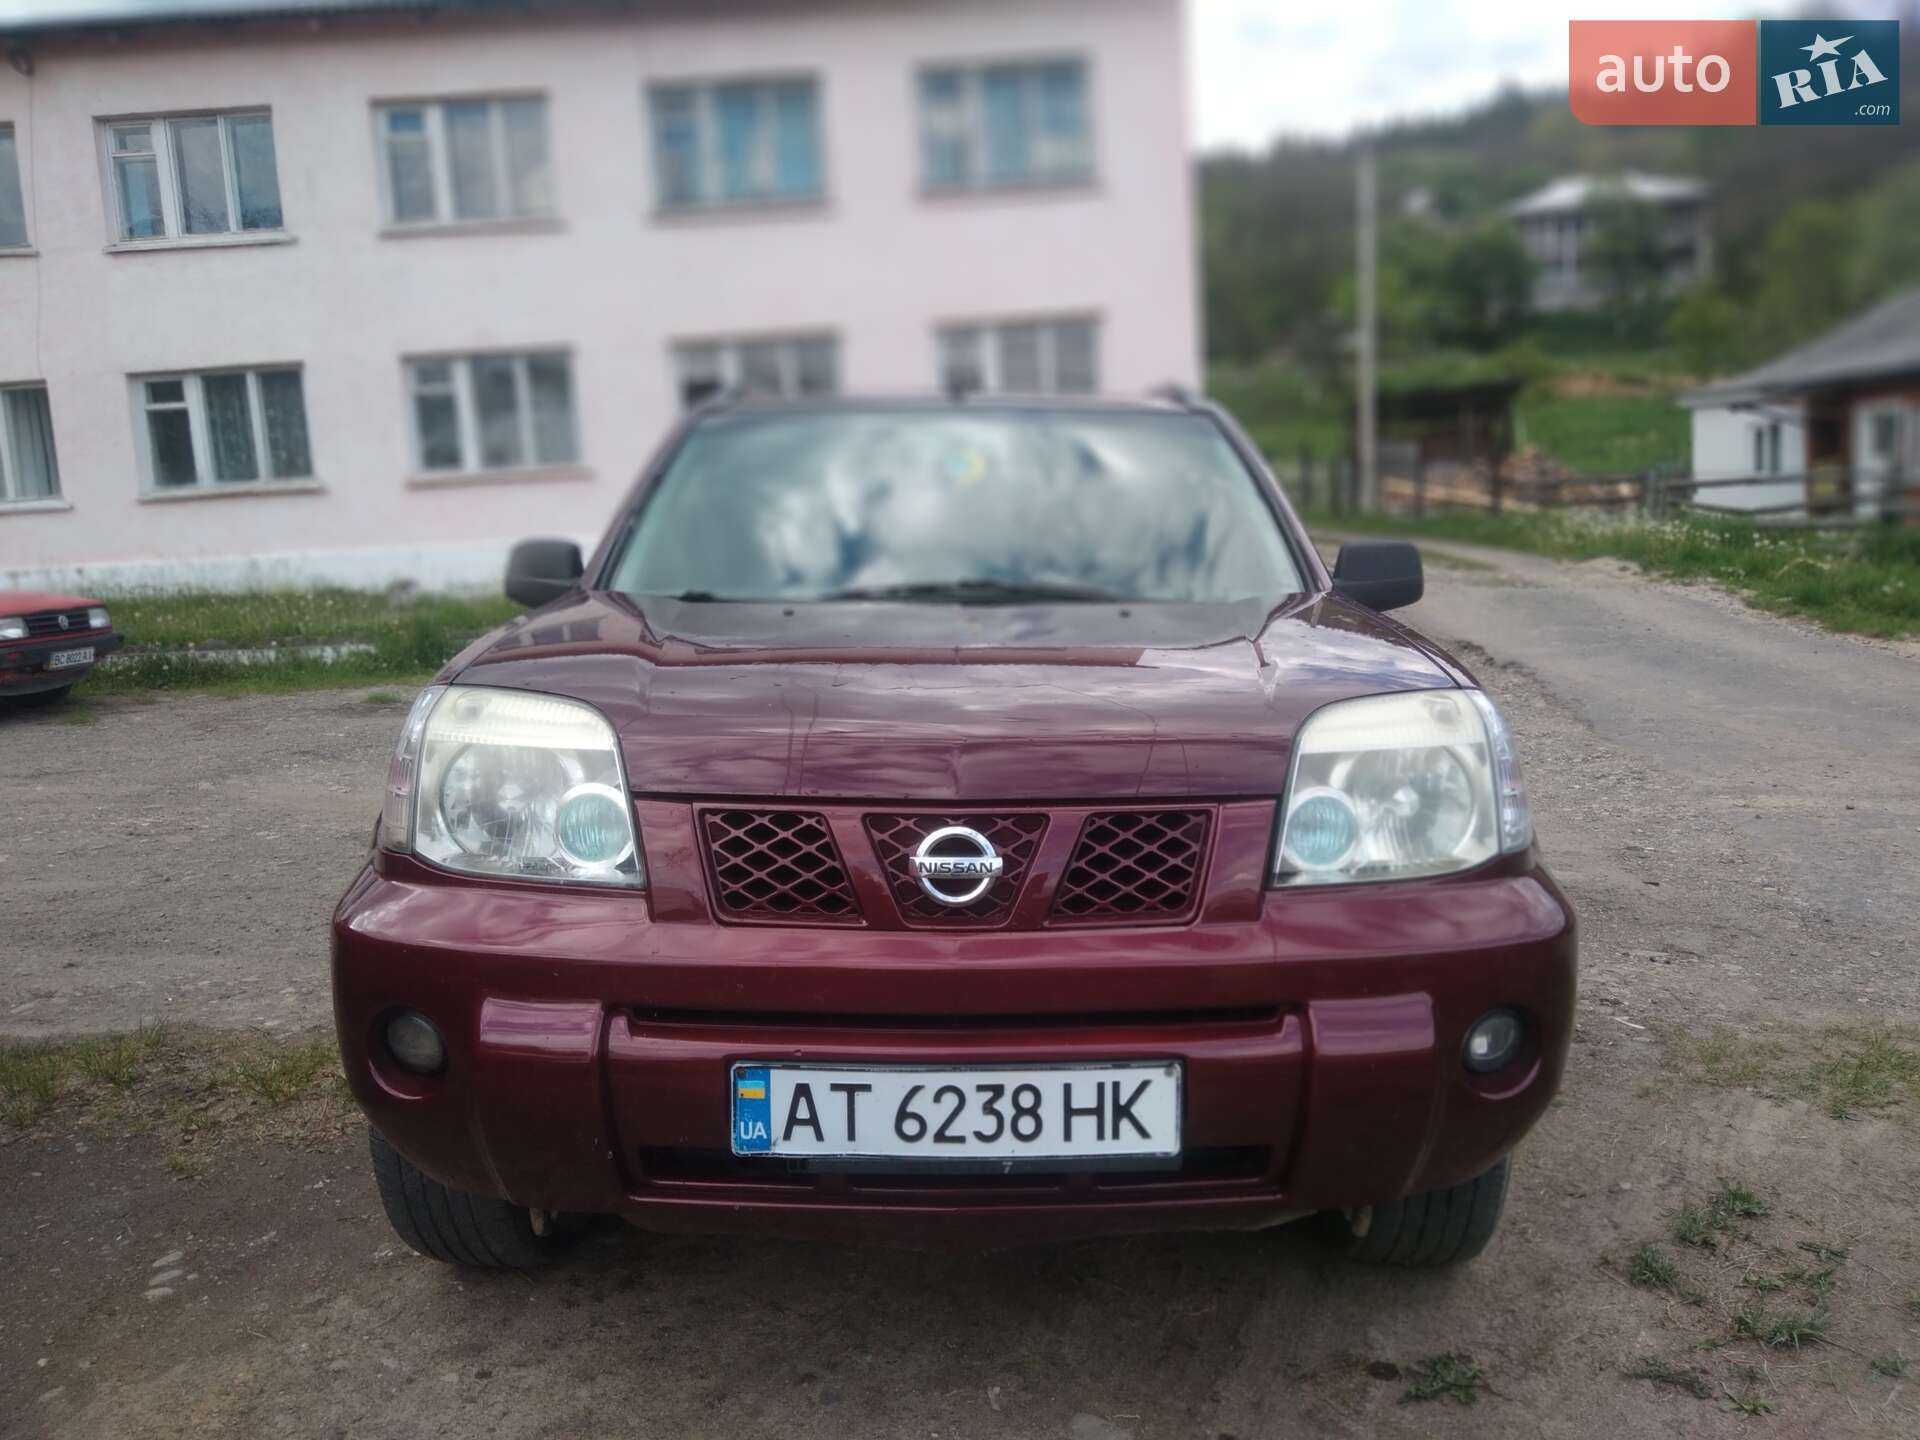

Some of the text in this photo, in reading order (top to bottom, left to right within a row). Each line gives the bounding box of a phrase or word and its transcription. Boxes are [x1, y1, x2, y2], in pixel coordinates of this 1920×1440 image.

[919, 862, 993, 873] NISSAN
[782, 1078, 1153, 1144] AT 6238 HK
[739, 1121, 767, 1140] UA
